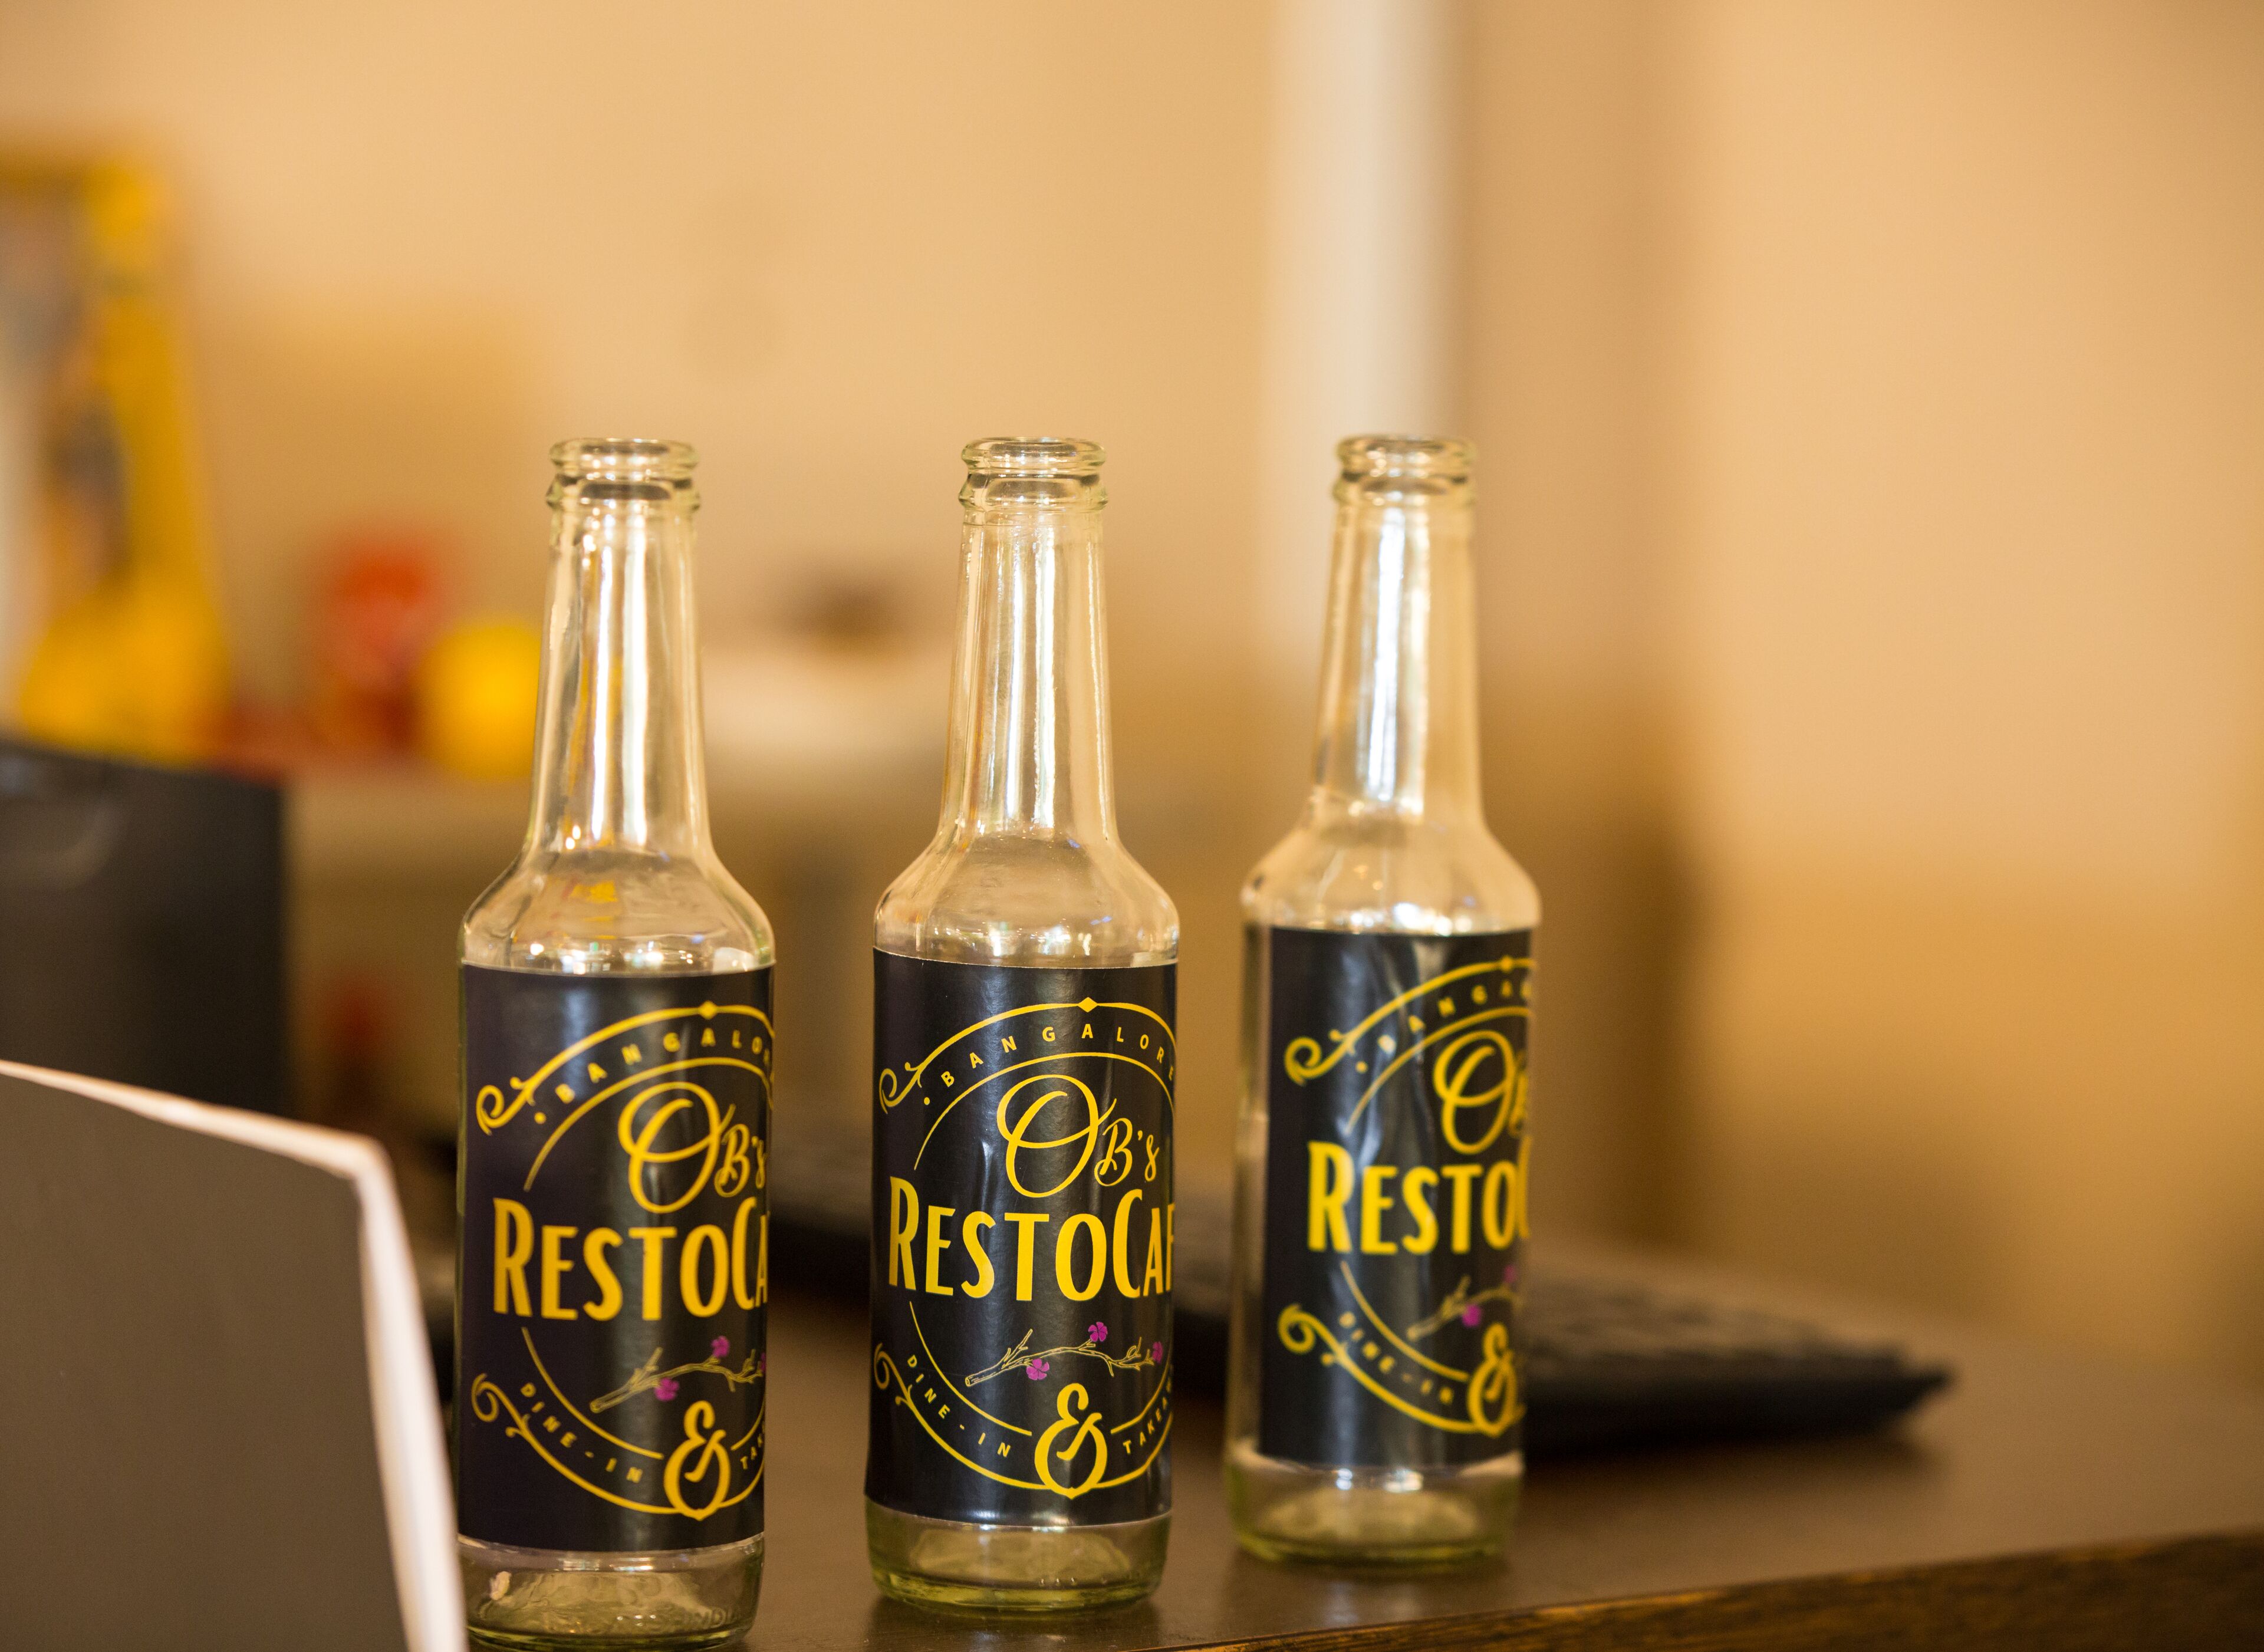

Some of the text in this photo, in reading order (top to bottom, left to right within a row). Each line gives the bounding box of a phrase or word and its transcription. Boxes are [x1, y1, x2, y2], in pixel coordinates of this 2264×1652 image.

[996, 1074, 1159, 1199] OB's
[493, 1197, 768, 1321] RESTOCA
[907, 1355, 1011, 1457] DINE-IN
[1034, 1383, 1107, 1499] &
[1467, 1322, 1517, 1437] &
[664, 1400, 730, 1521] &
